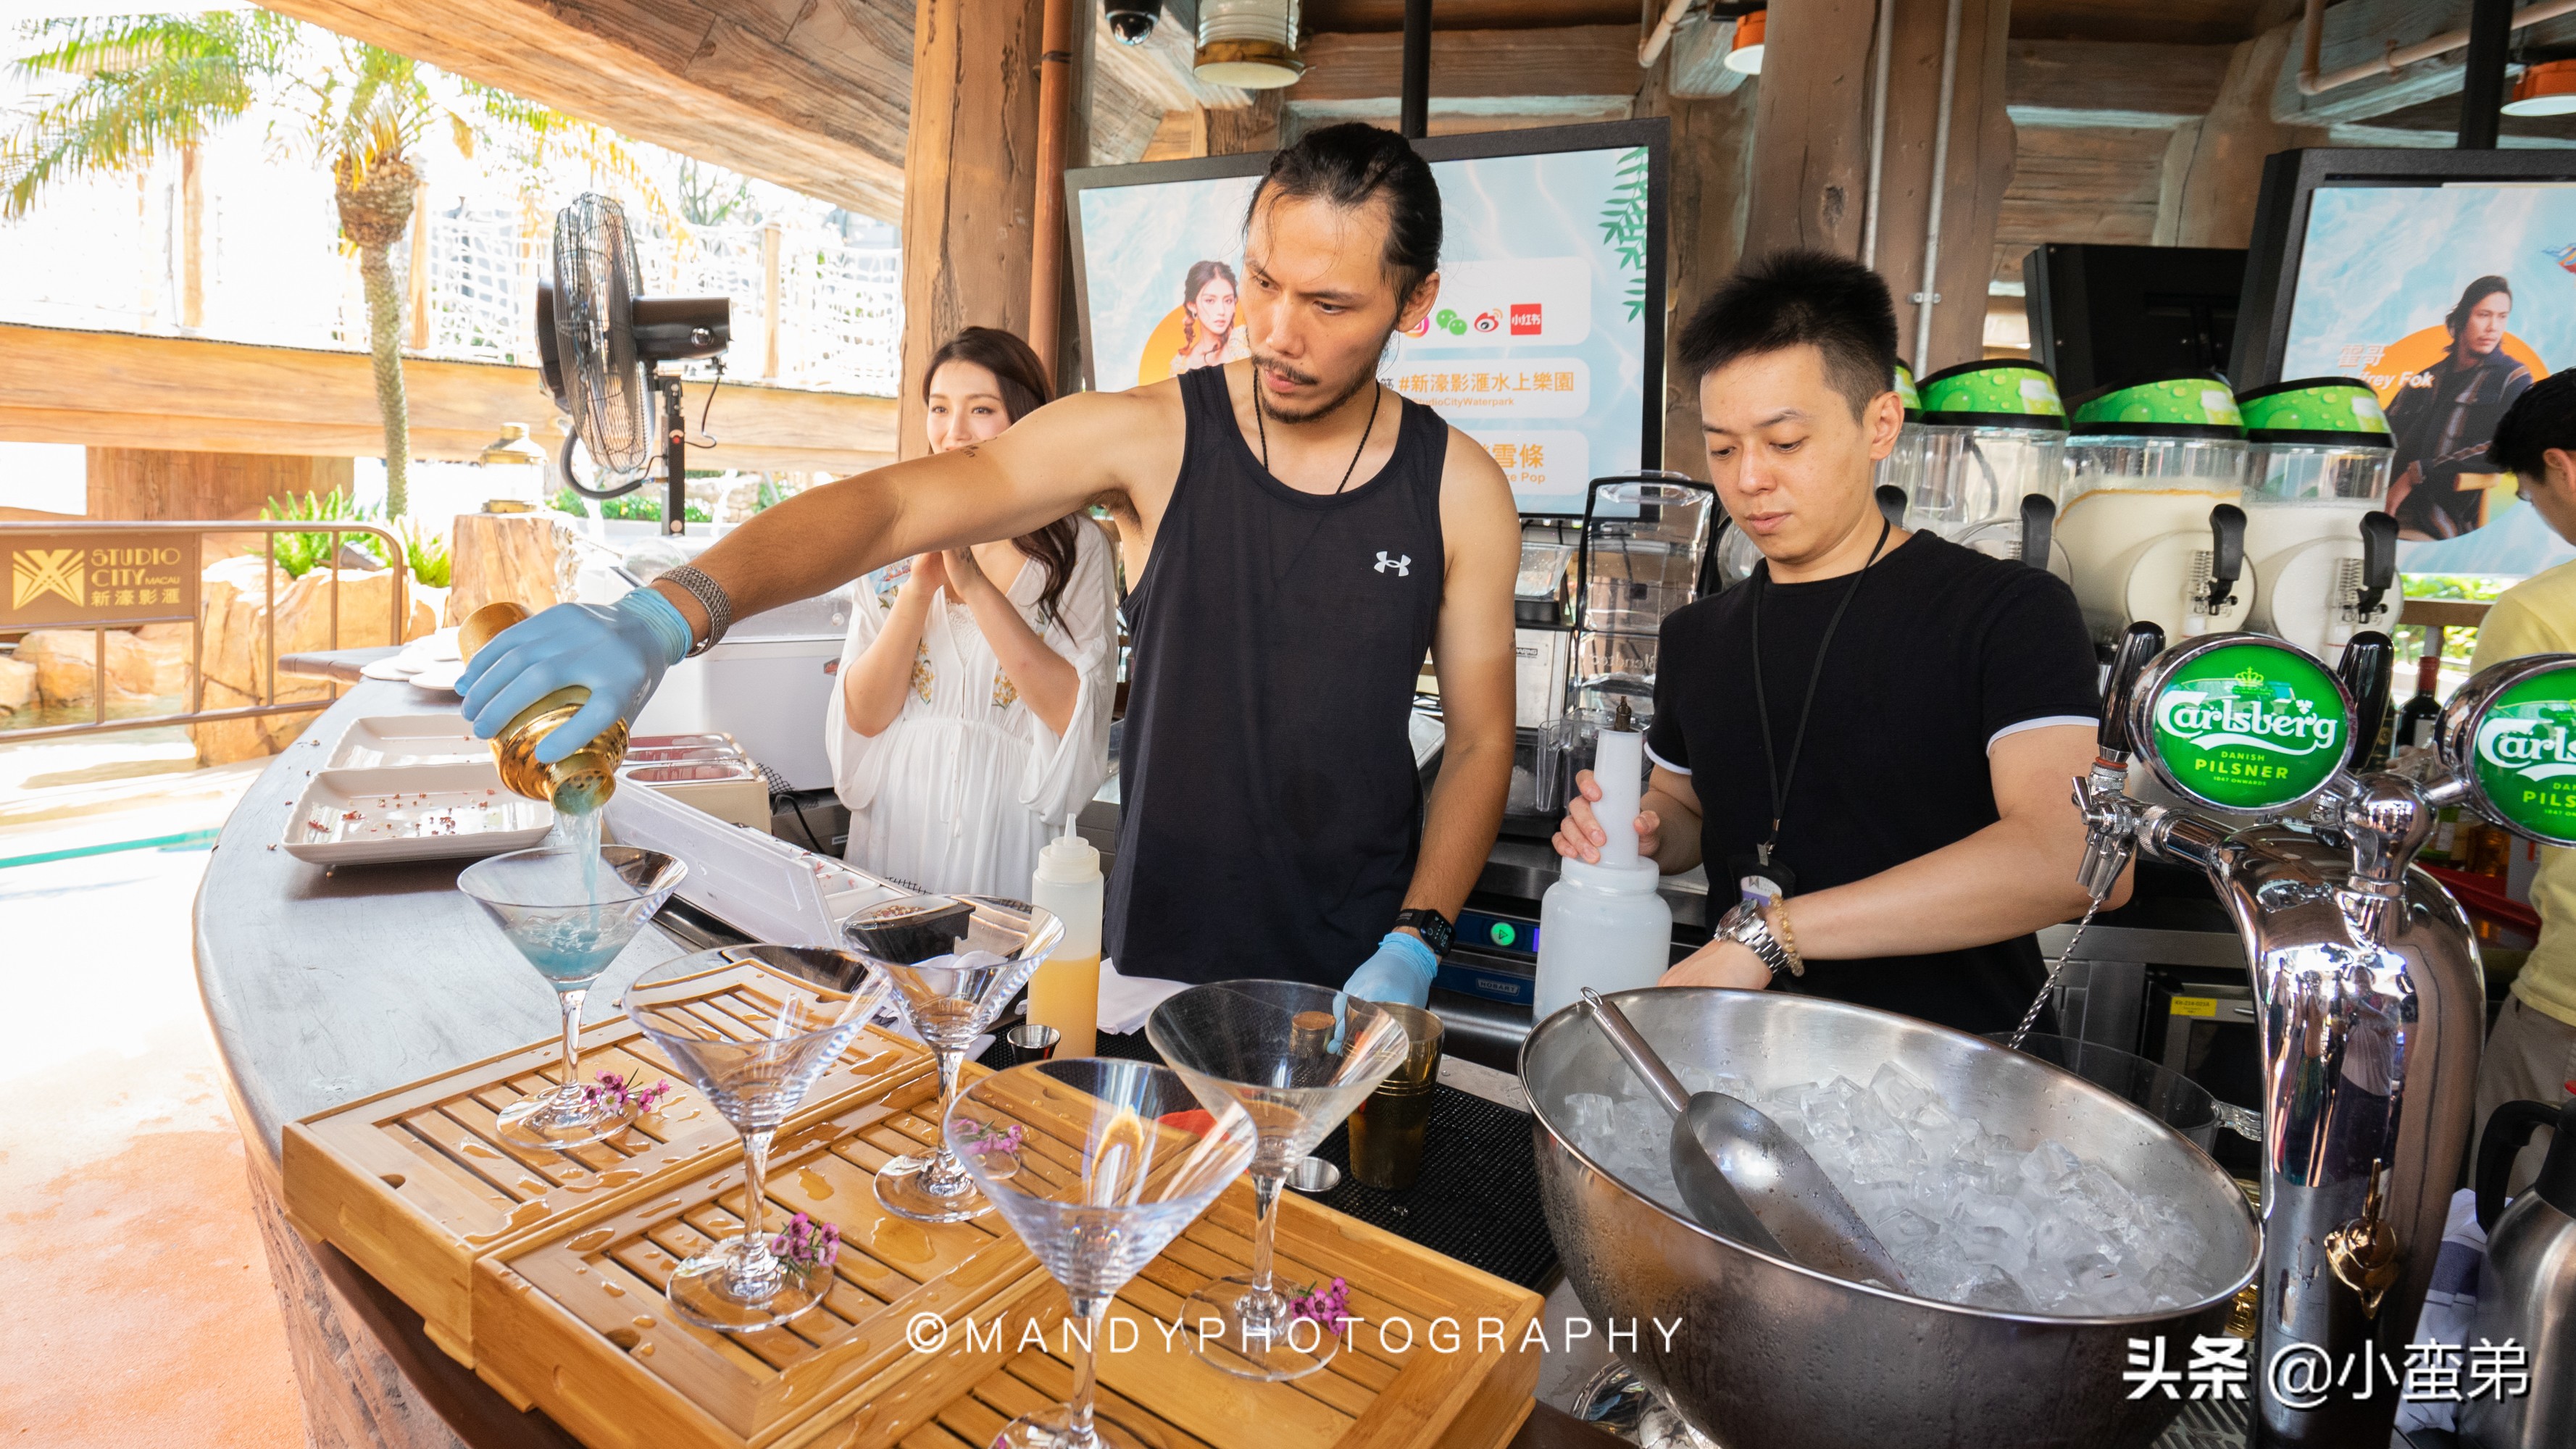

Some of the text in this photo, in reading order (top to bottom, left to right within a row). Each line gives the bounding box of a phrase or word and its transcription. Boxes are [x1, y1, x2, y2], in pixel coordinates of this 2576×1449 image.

[1512, 313, 1541, 326] 小红书
[2398, 371, 2435, 388] Fok
[1482, 443, 1543, 469] 雪條
[1521, 472, 1546, 485] Pop
[91, 548, 180, 567] STUDIO
[91, 568, 146, 588] CITY
[2156, 690, 2338, 749] Carlsberg
[2221, 751, 2265, 761] DANISH
[2194, 758, 2290, 780] PILSNER
[2231, 777, 2267, 786] ONWARDS
[1480, 982, 1515, 992] HOBART
